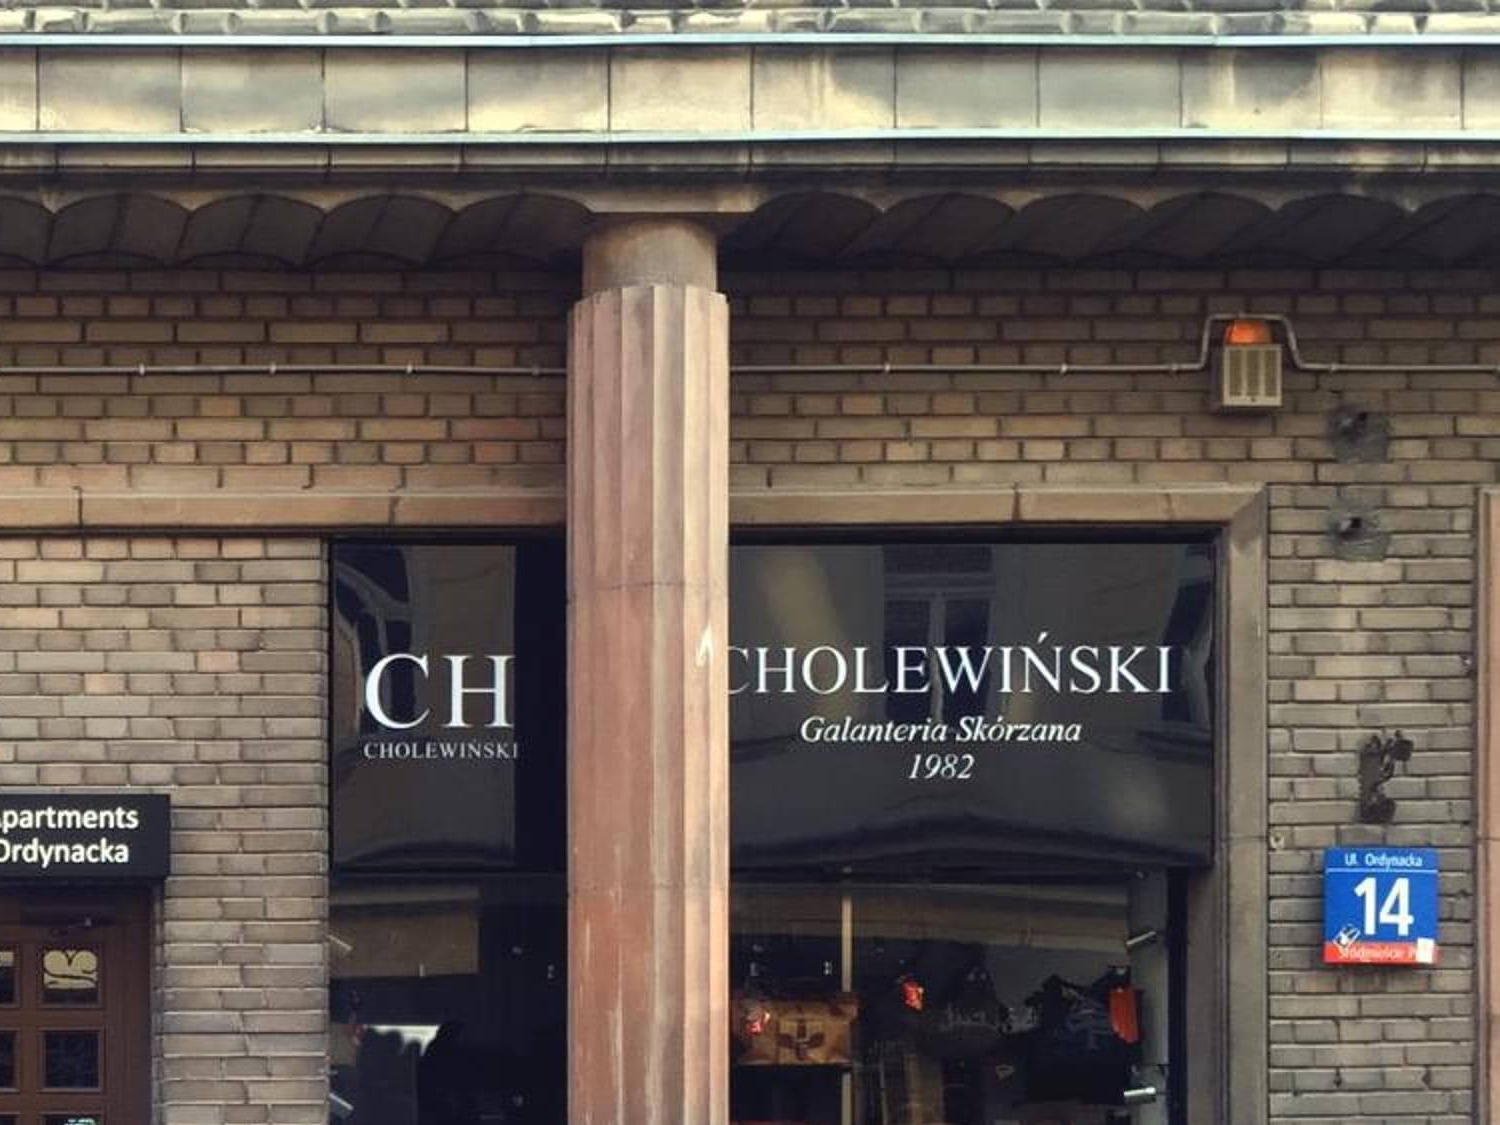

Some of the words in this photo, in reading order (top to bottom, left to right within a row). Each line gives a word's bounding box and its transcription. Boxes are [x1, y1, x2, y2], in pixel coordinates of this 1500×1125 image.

[365, 653, 516, 729] CH
[800, 715, 948, 743] Galanteria
[955, 715, 1082, 743] Skórzana
[363, 737, 519, 760] CHOLEWIŃSKI
[908, 754, 975, 780] 1982
[1354, 876, 1415, 936] 14
